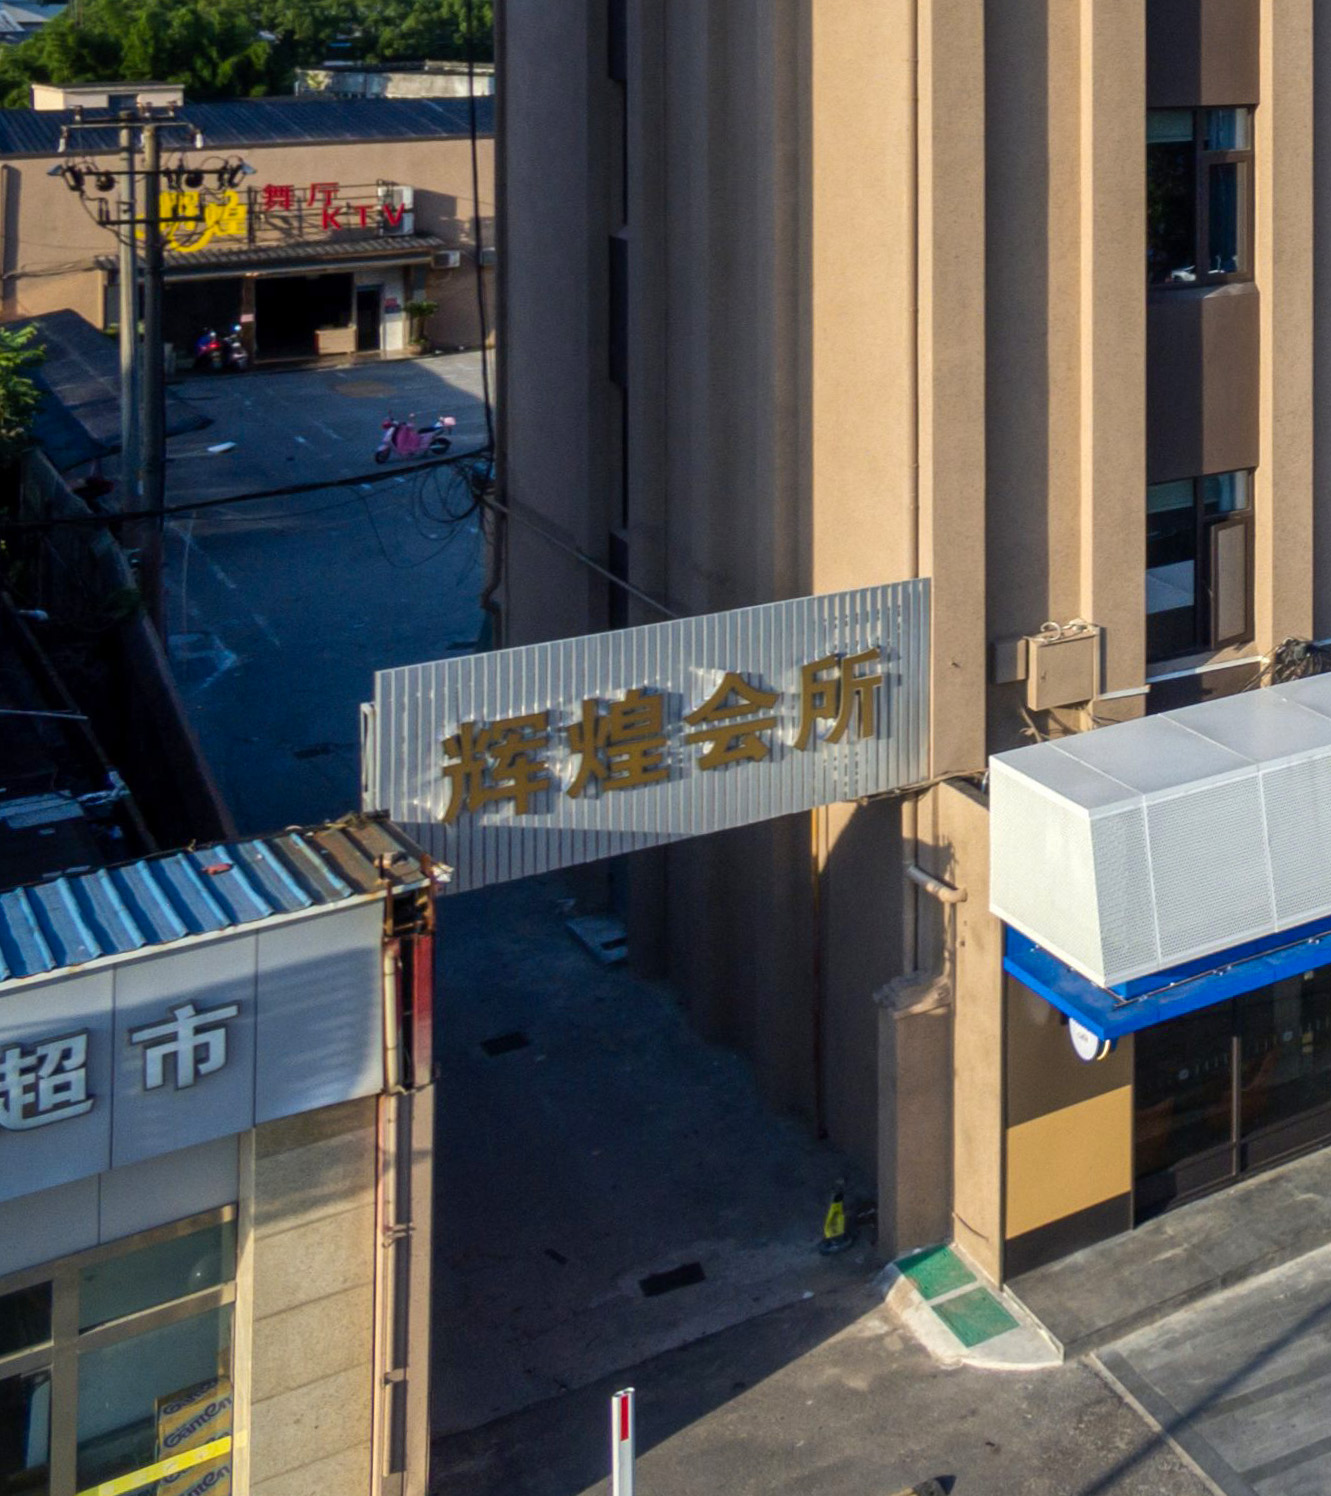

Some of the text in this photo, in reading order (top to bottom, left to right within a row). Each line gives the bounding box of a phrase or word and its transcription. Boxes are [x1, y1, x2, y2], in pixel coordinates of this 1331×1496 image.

[263, 182, 340, 211] 舞厅
[442, 646, 883, 826] 辉煌会所
[0, 1003, 240, 1133] 超市
